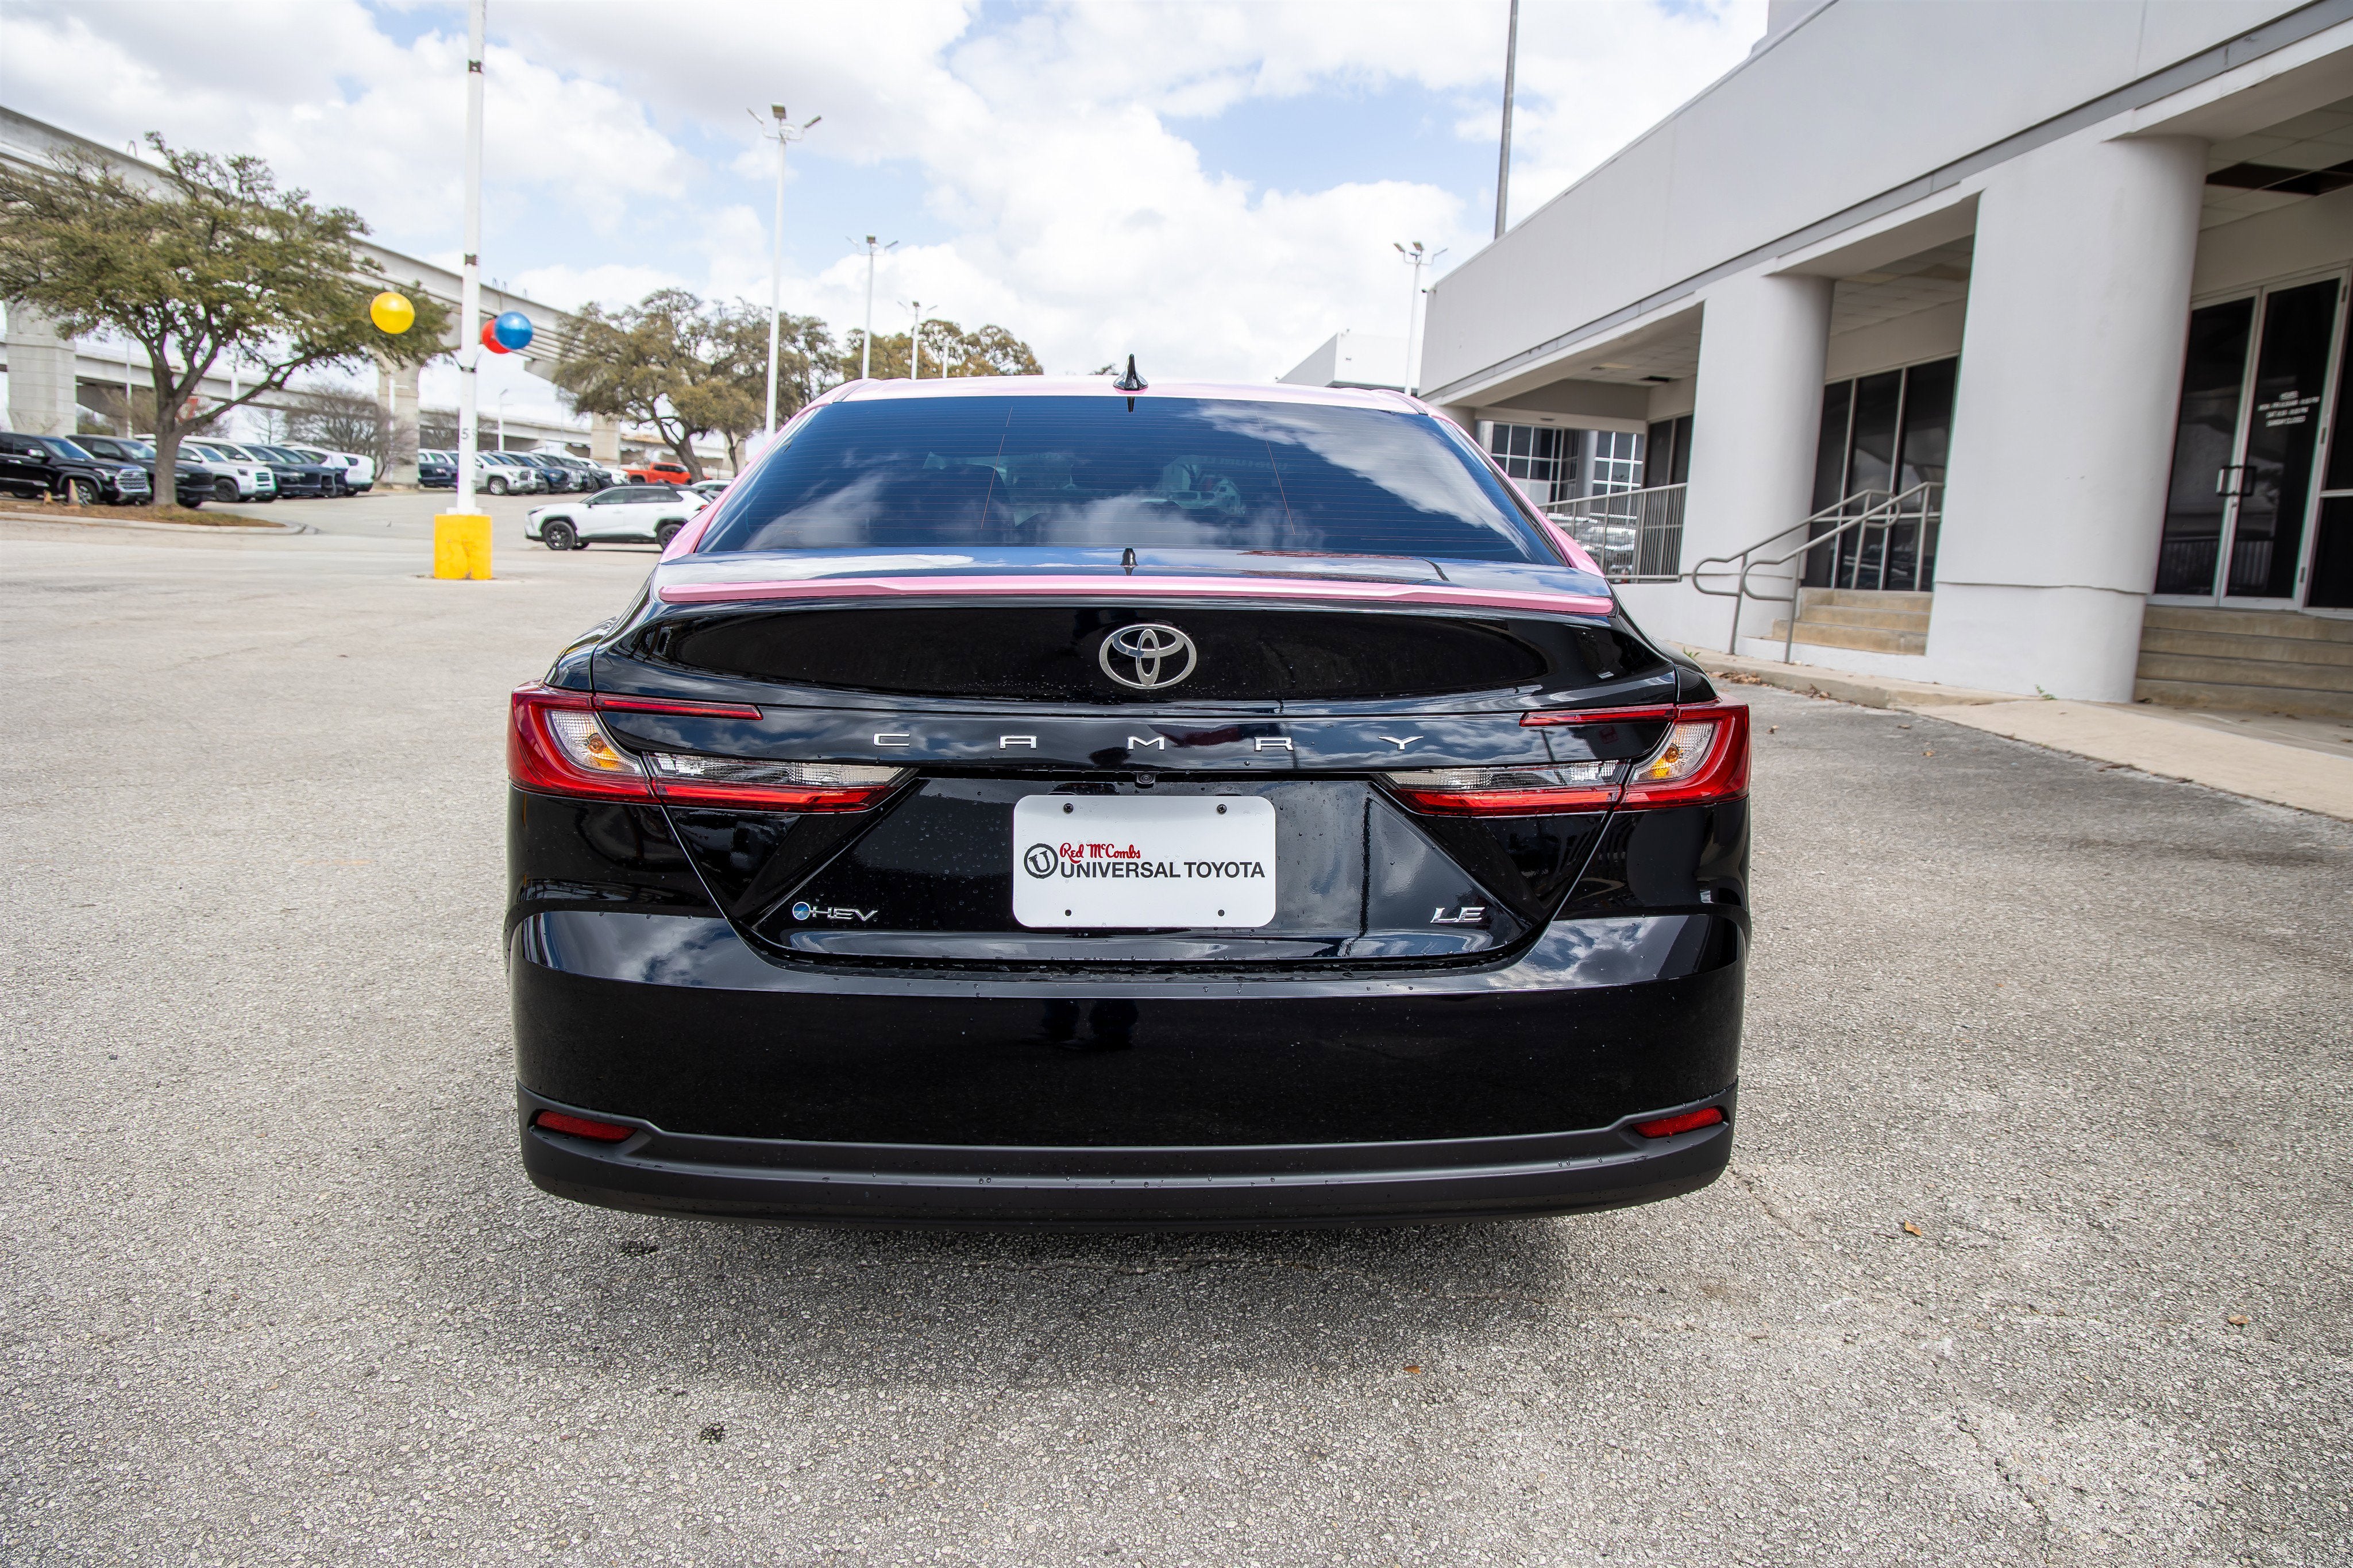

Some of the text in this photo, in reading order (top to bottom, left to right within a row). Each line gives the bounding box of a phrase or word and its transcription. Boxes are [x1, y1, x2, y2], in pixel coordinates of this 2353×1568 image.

[873, 733, 1424, 751] CAMRY
[1059, 843, 1141, 864] Red McCombs
[1060, 862, 1266, 878] UNIVERSAL TOYOTA
[1430, 907, 1485, 923] LE
